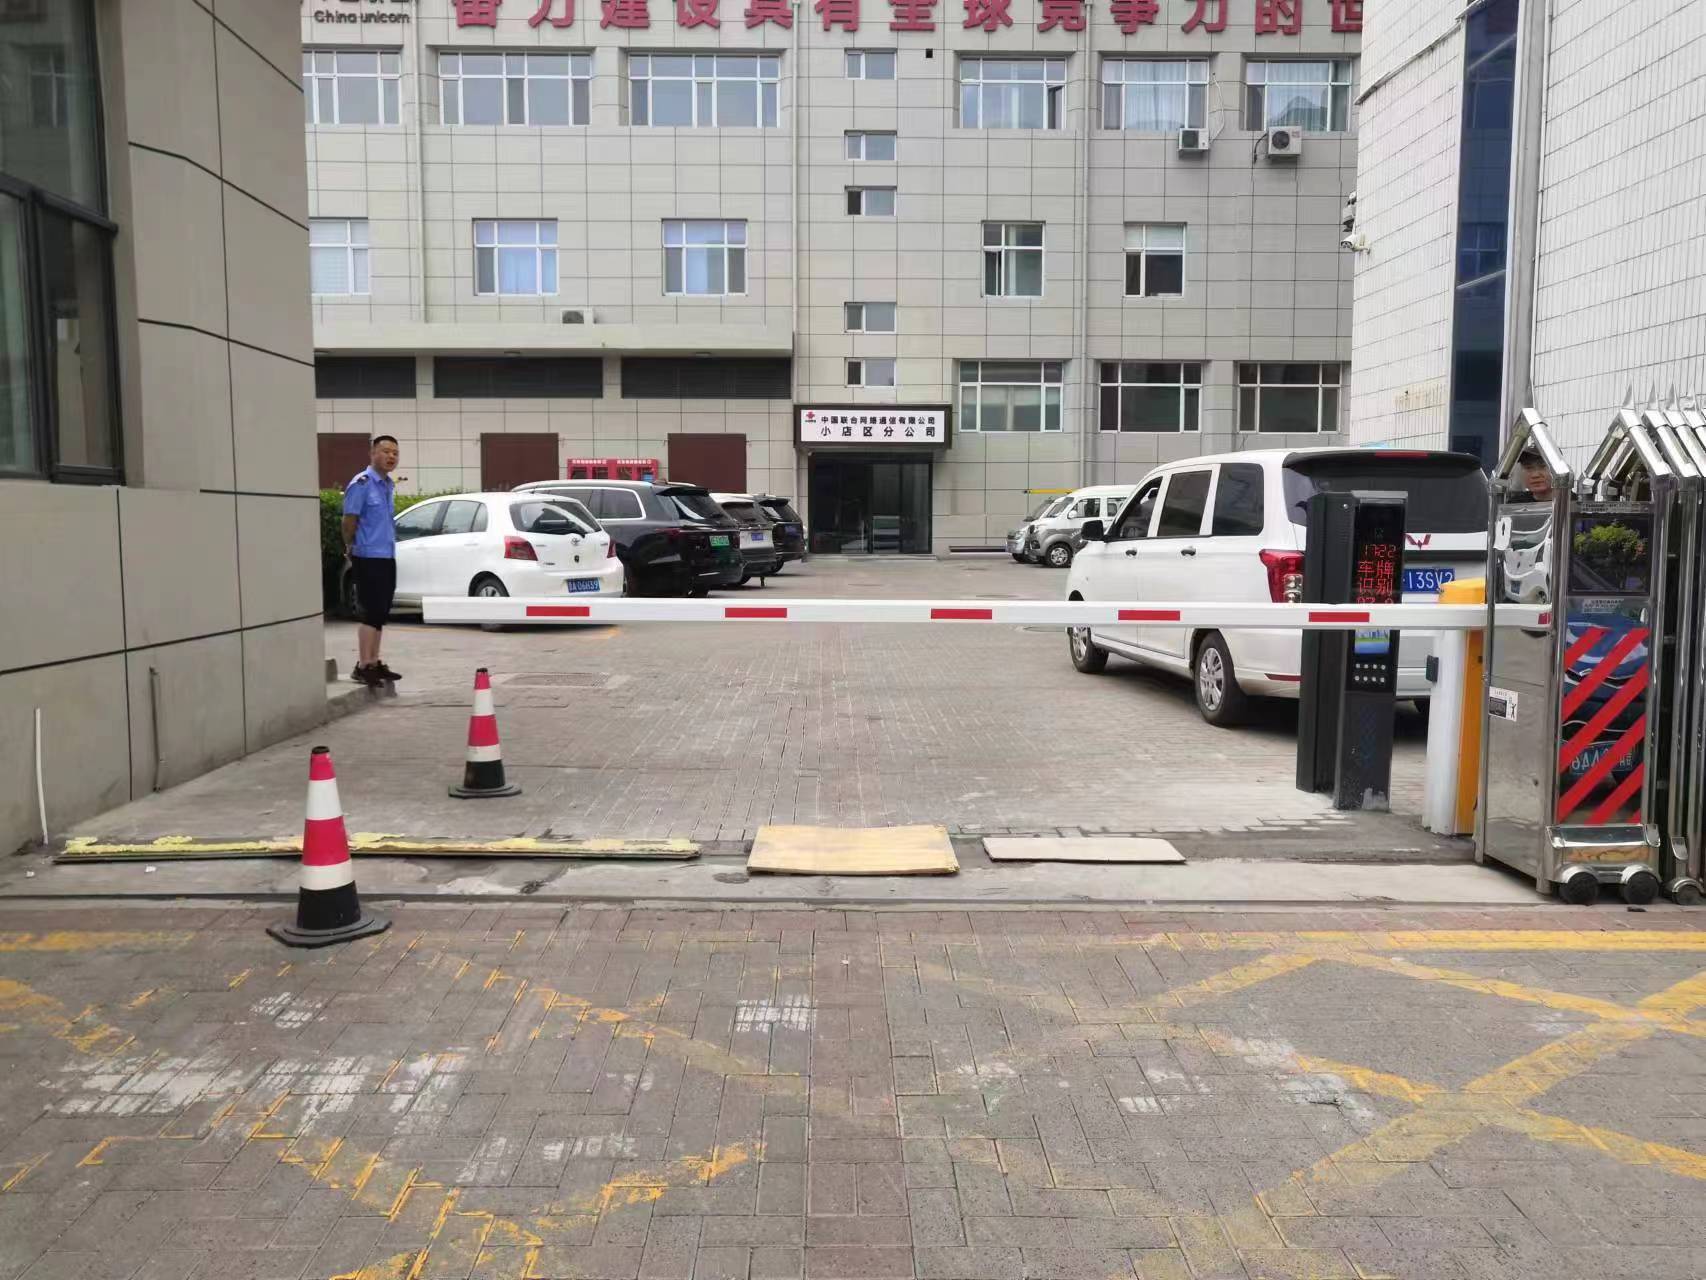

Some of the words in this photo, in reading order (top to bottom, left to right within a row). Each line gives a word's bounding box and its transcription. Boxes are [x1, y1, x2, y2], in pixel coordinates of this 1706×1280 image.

[313, 9, 358, 24] China
[360, 10, 410, 24] unicom
[821, 426, 935, 437] 小店区分公司
[1357, 560, 1394, 578] 车牌
